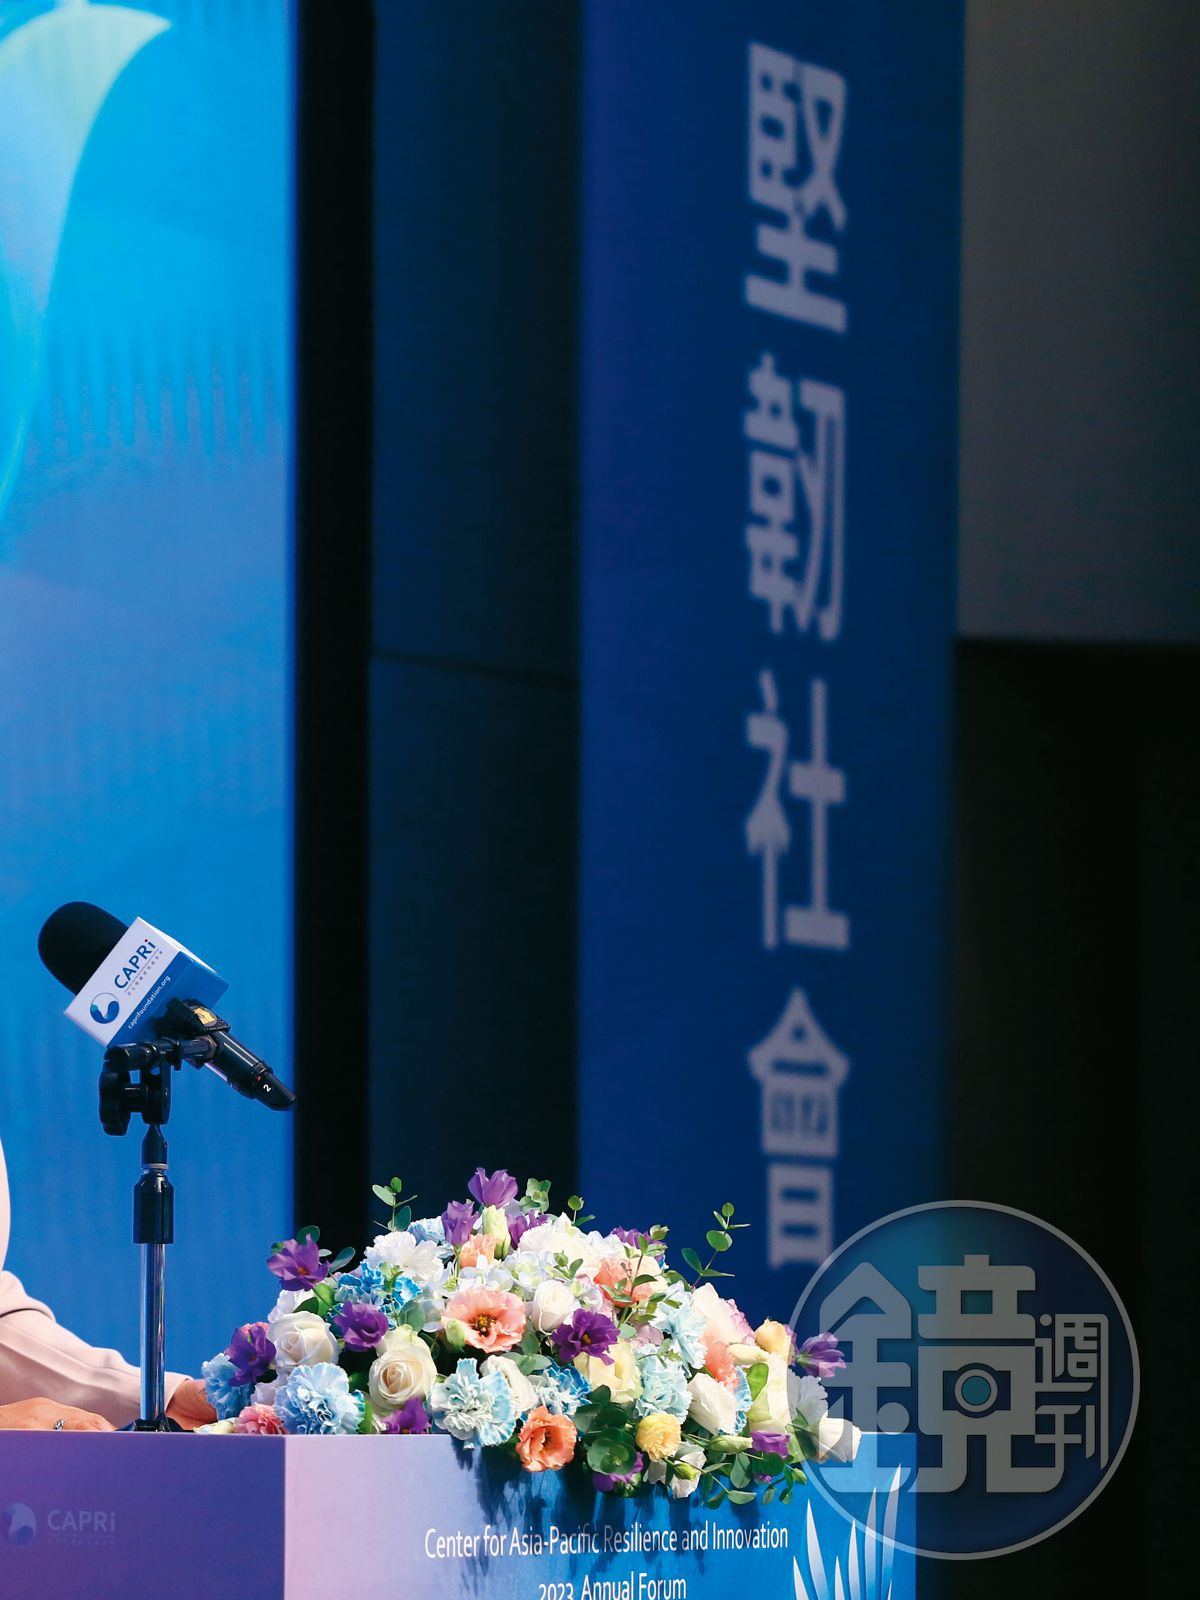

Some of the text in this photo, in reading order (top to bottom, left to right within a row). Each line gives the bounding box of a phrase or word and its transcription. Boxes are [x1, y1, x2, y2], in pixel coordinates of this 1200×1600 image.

[128, 975, 171, 1029] caprifoundation.org
[263, 1084, 271, 1092] 2
[425, 1520, 789, 1559] Center for Asia-Pacific Resilience and Innovation
[538, 1572, 687, 1600] 2023 Annual Forum
